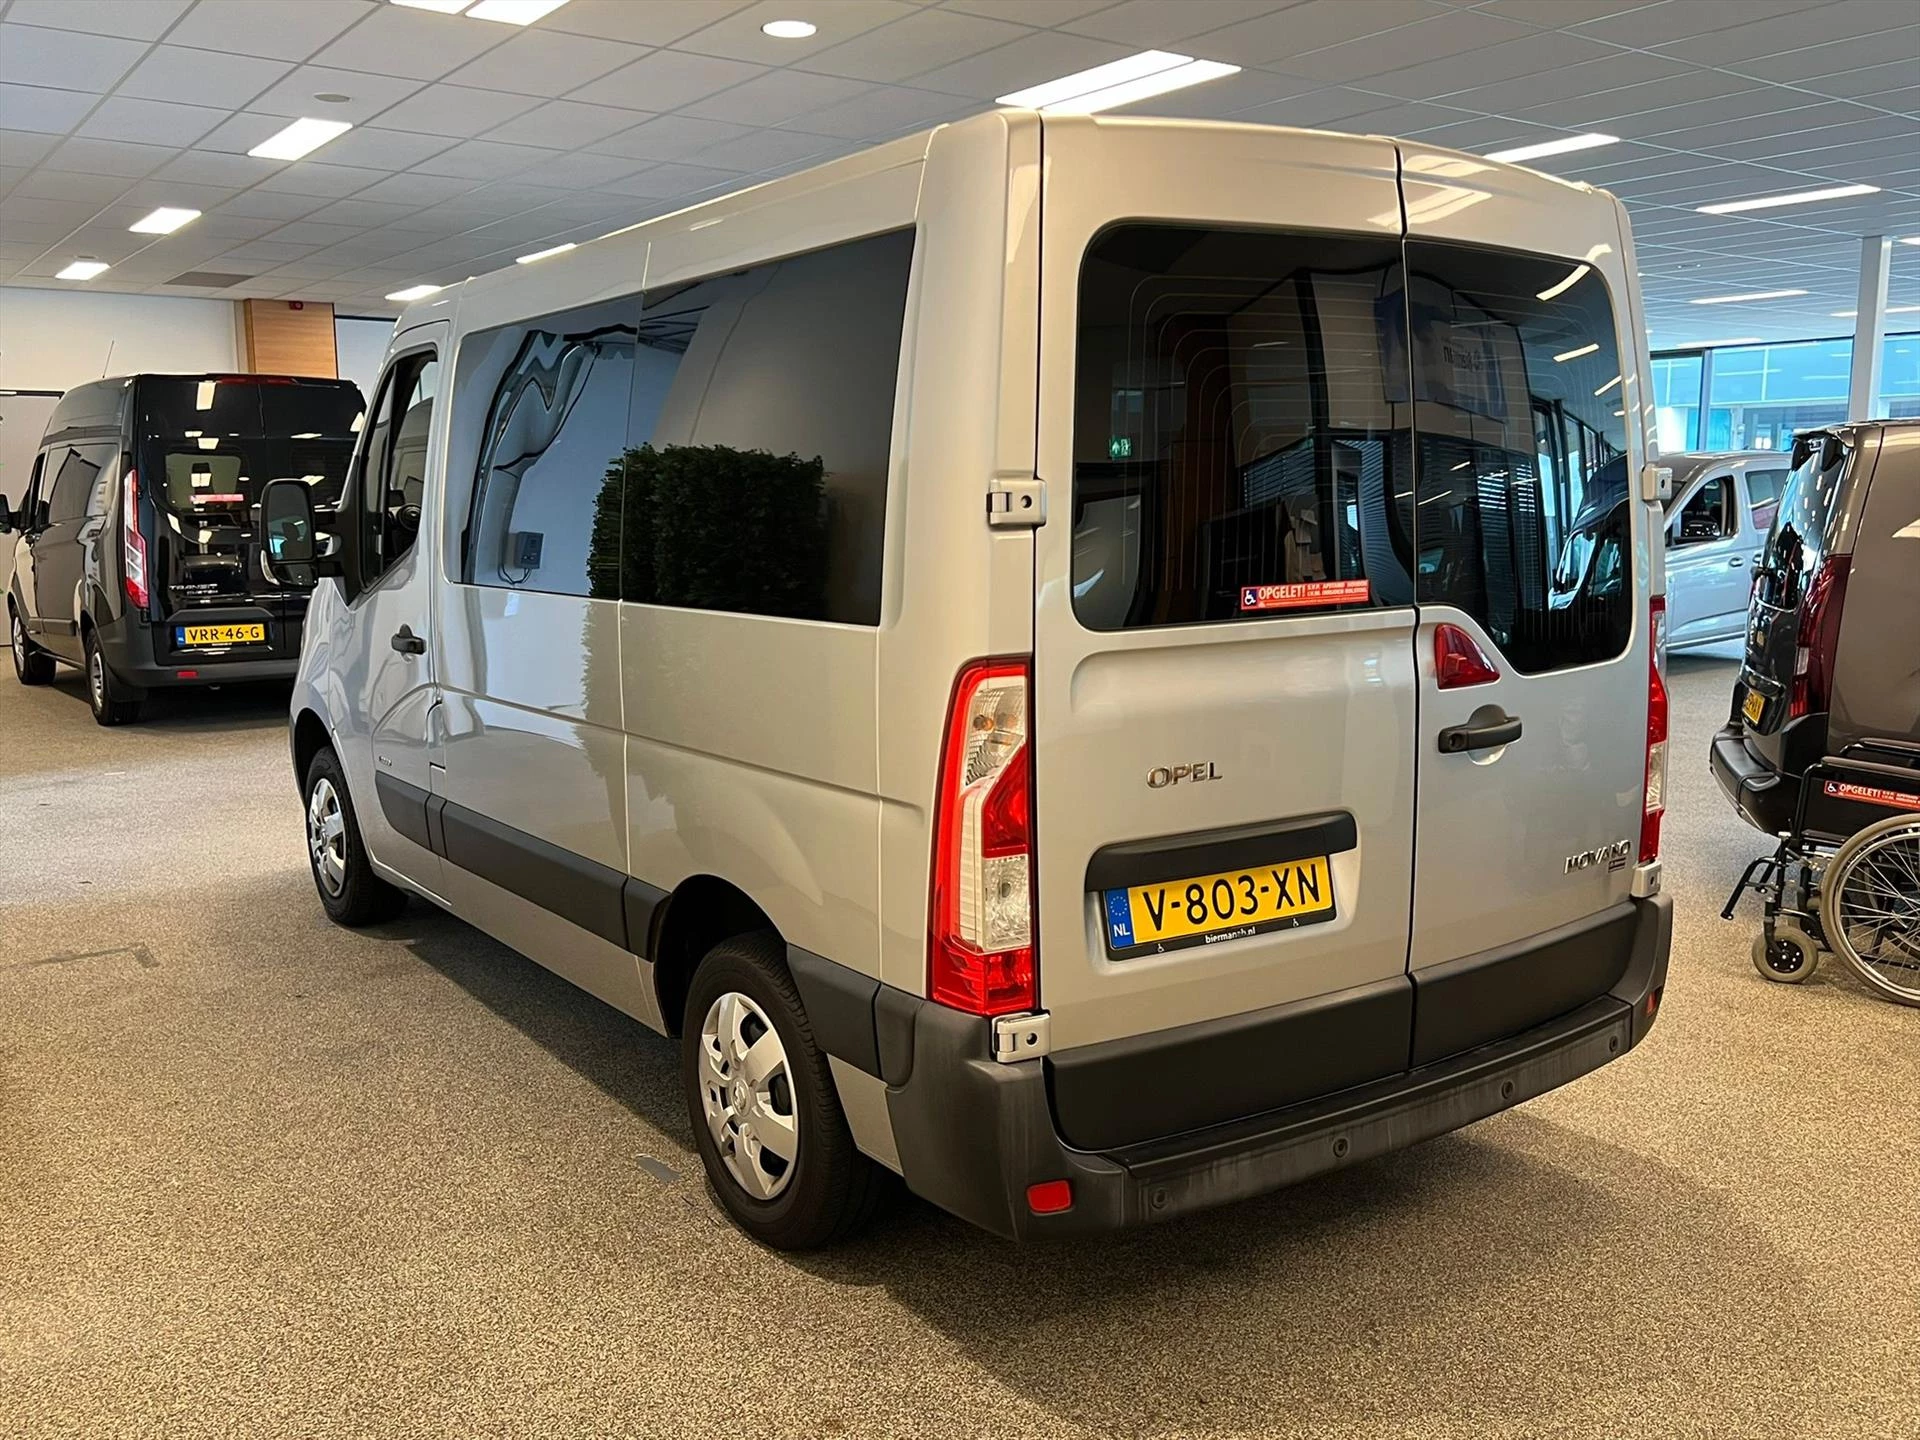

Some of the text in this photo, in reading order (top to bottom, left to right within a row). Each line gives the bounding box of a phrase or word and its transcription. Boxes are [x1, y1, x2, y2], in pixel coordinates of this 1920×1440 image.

[1258, 585, 1306, 600] OPGELET!
[189, 626, 260, 641] VRR-46-G
[1147, 762, 1223, 789] OPEL
[1839, 783, 1881, 798] OPGELET!
[1564, 840, 1631, 874] MOVANO
[1113, 863, 1320, 937] NL V-803-XN
